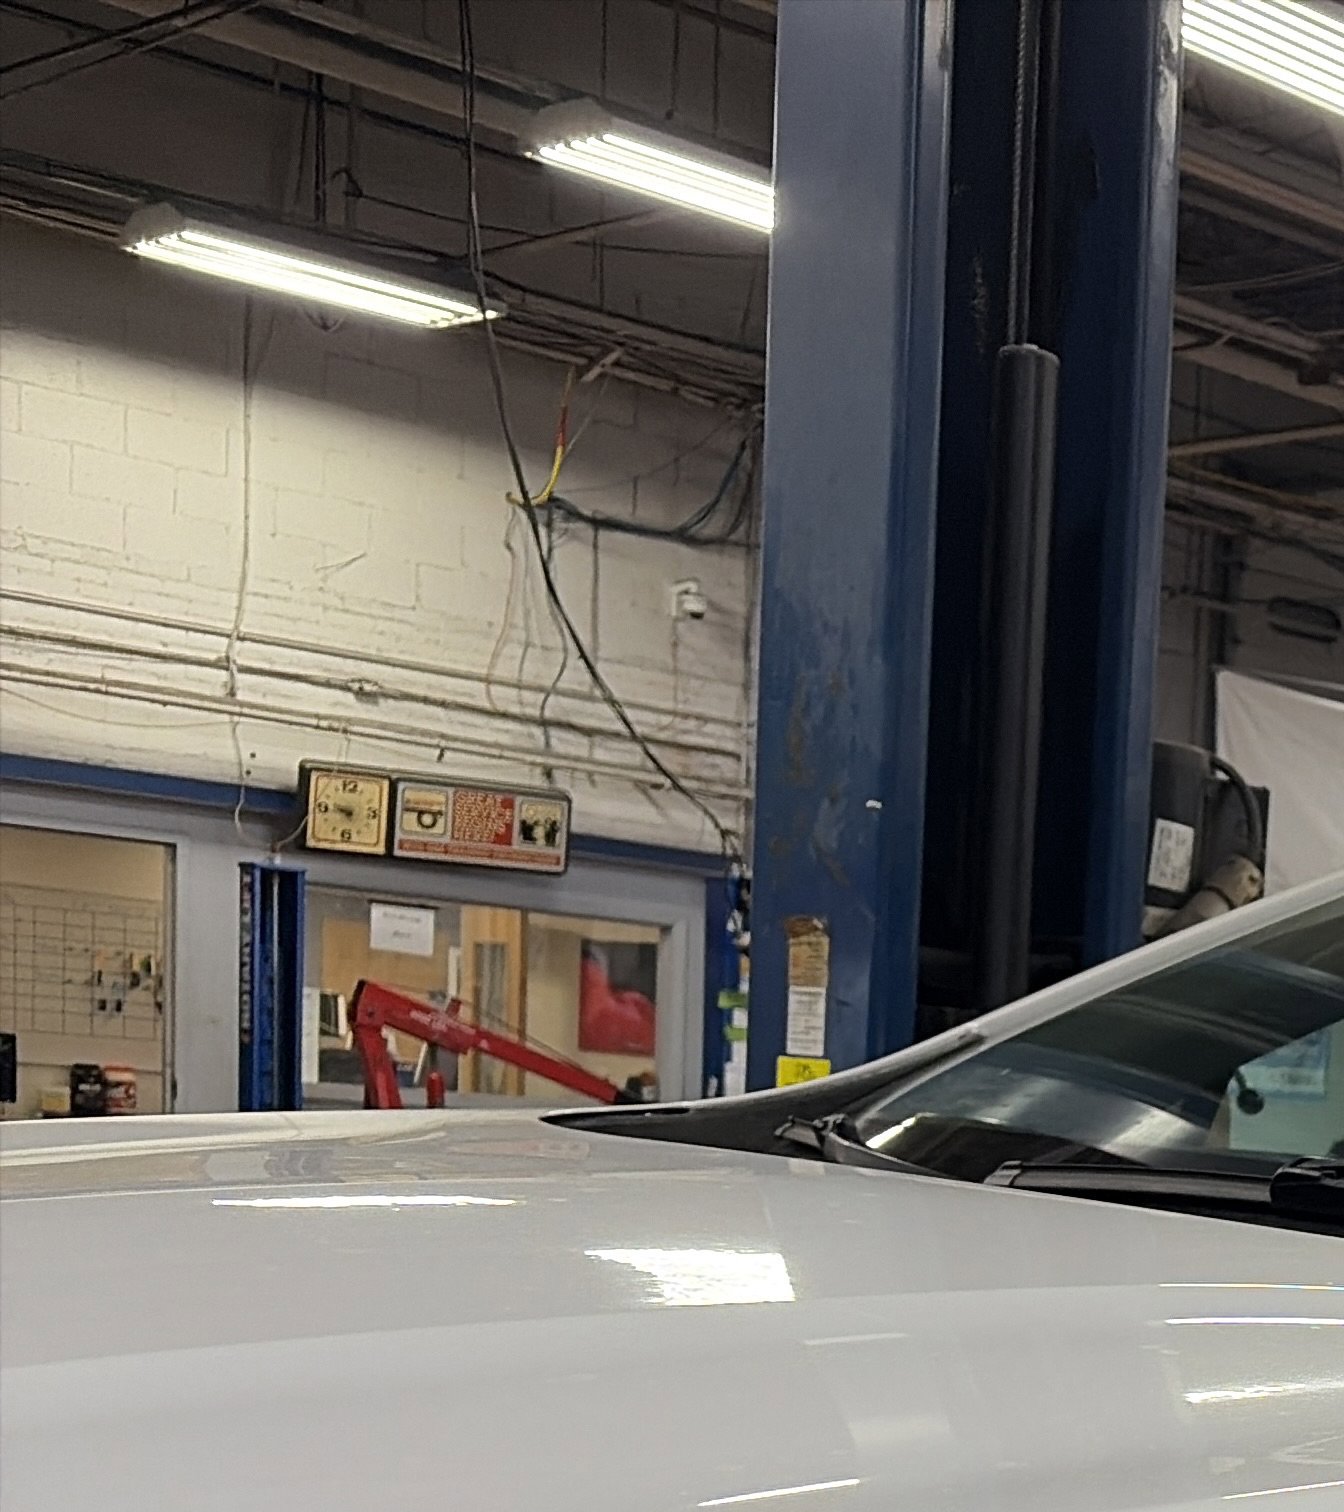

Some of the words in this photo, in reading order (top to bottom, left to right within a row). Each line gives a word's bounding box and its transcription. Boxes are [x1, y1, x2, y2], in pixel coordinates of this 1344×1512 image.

[342, 780, 358, 793] 12
[317, 801, 329, 813] 9
[367, 806, 378, 819] 3
[341, 828, 352, 841] 6
